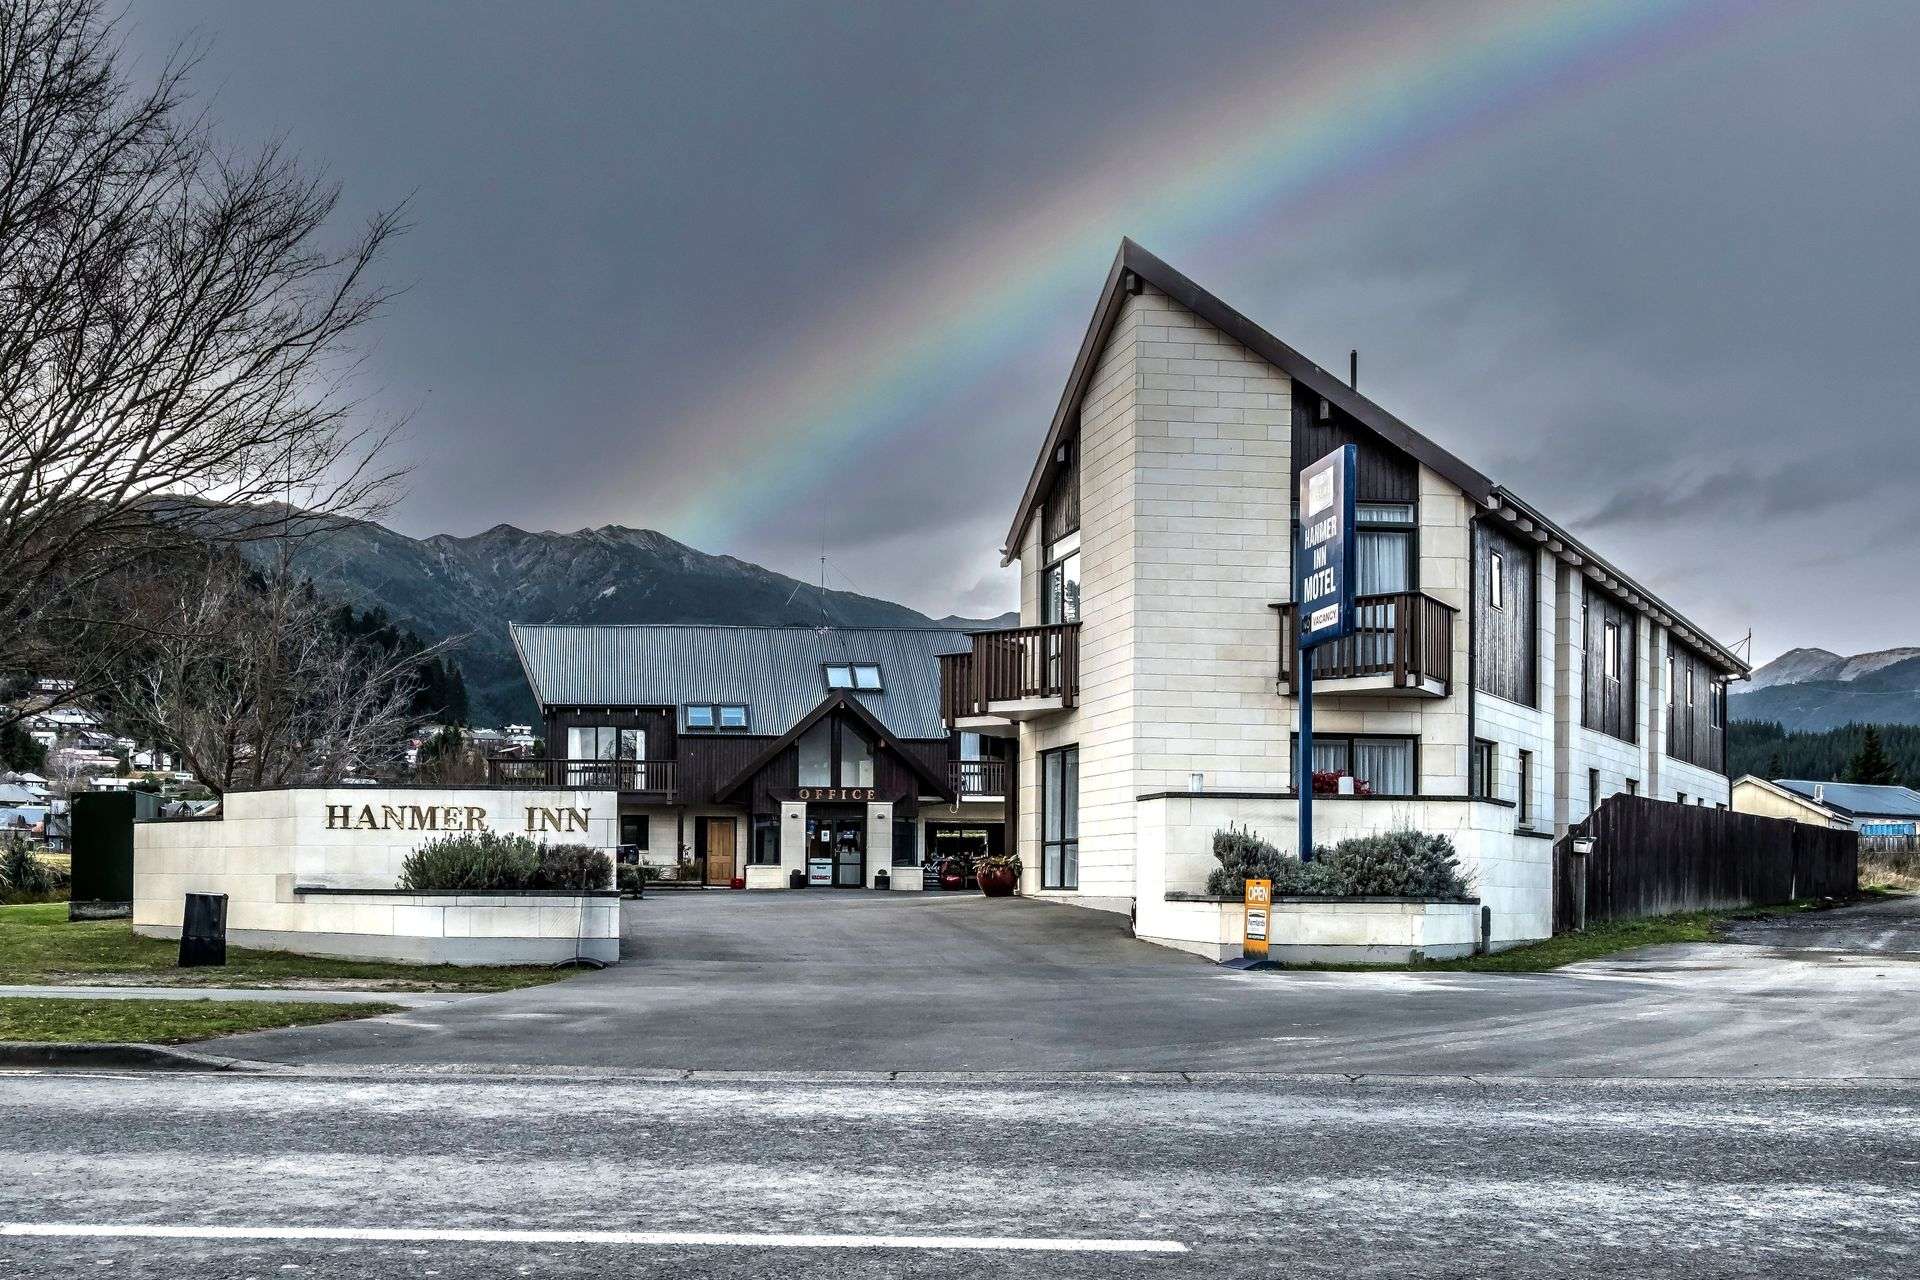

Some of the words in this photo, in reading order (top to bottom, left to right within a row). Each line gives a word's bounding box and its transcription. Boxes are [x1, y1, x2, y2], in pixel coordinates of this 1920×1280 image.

[1304, 515, 1337, 550] HANMER
[1313, 544, 1327, 571] INN
[1304, 566, 1336, 603] MOTEL
[1312, 610, 1337, 626] VACANCY
[799, 789, 876, 800] OFFICE
[325, 804, 489, 831] HANMER
[524, 805, 592, 832] INN
[1248, 886, 1268, 902] OPEN
